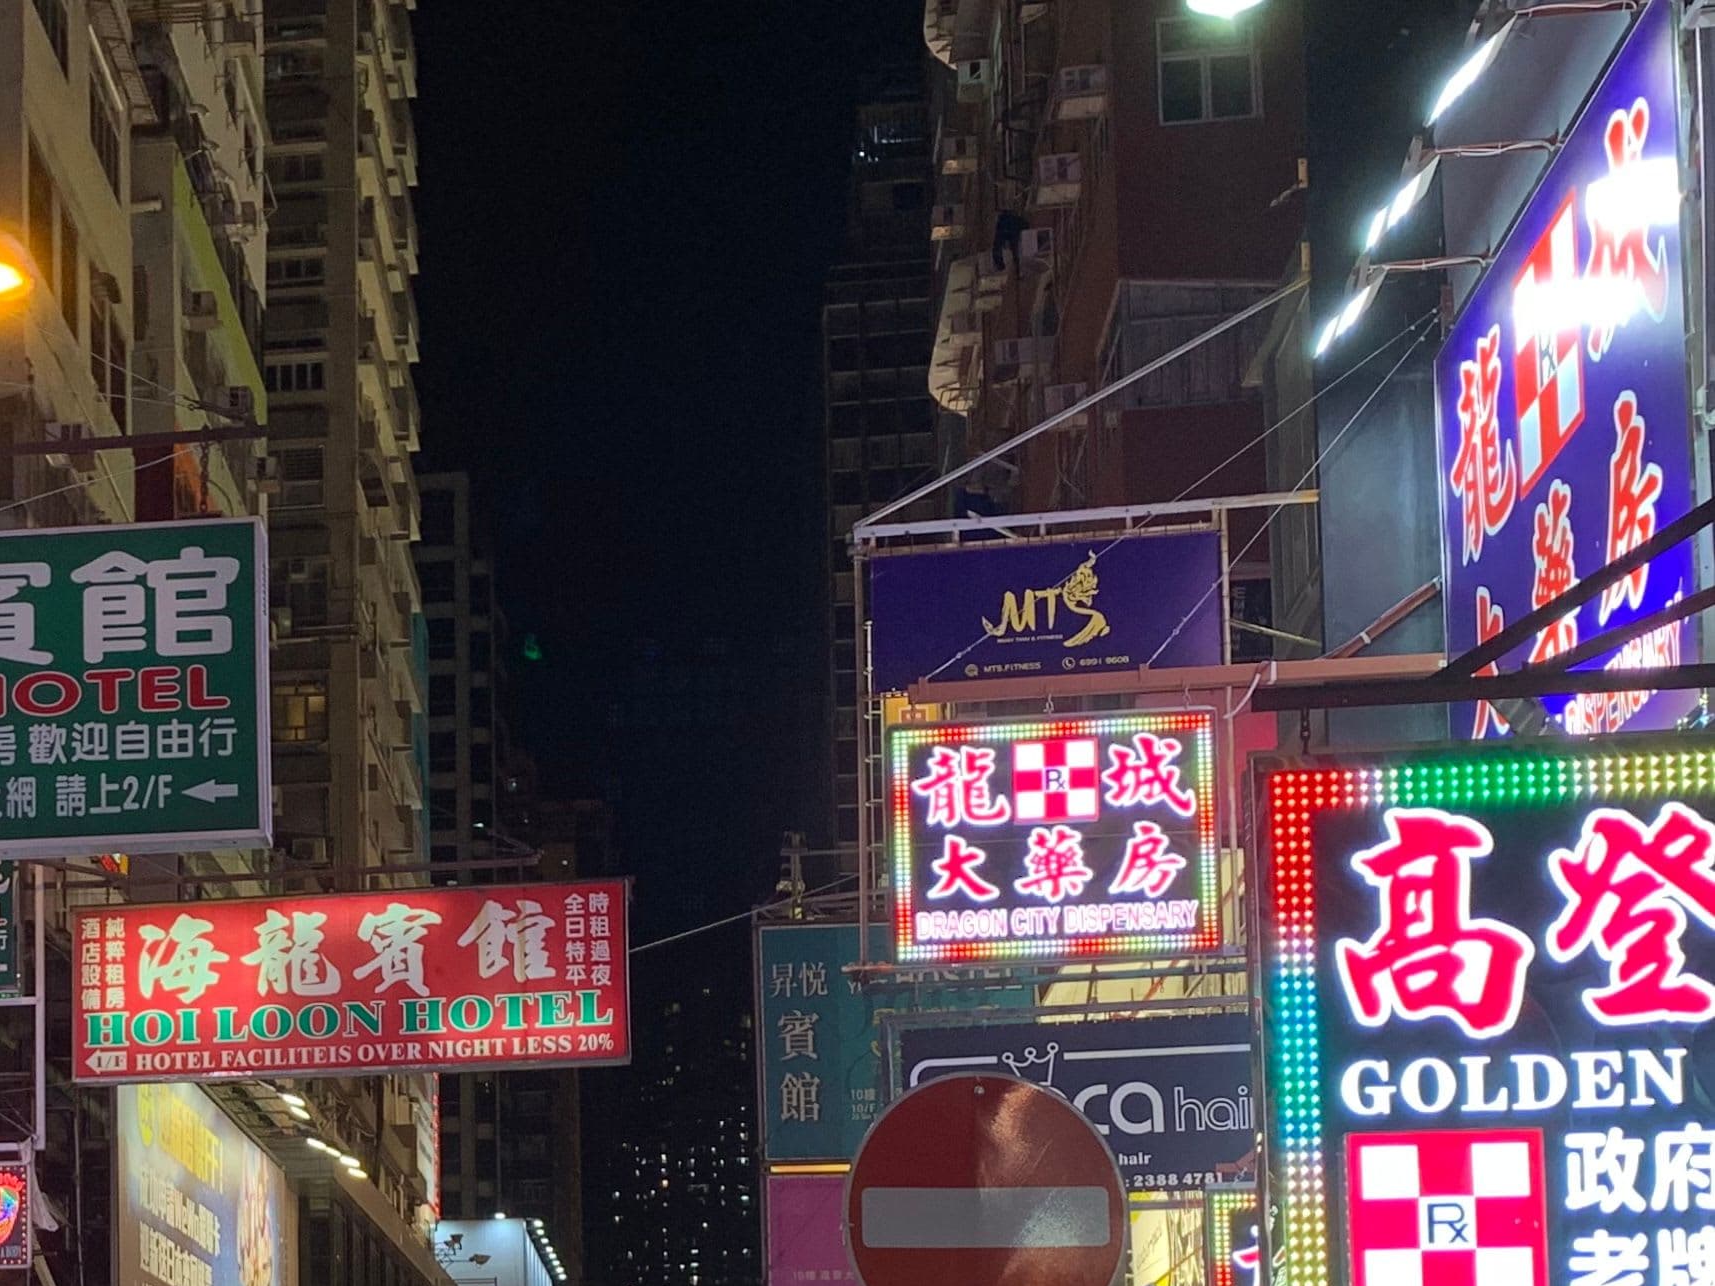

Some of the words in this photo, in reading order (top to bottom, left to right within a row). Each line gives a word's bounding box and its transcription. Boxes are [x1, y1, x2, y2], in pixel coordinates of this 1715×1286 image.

[1452, 324, 1517, 567] 龍
[27, 718, 237, 765] 歡迎自由行
[913, 745, 1012, 828] 龍
[1102, 732, 1197, 818] 城
[928, 821, 1188, 902] 大藥房
[138, 898, 558, 1003] 海龍賓館
[917, 909, 1008, 941] DRAGON
[1011, 907, 1061, 937] CITY
[1064, 900, 1198, 935] DISPENSARY
[1335, 802, 1715, 1038] 高登
[84, 1008, 202, 1048] HOI
[213, 1001, 385, 1044] LOON
[400, 989, 615, 1036] HOTEL
[94, 1055, 126, 1070] 1/F
[135, 1050, 217, 1072] HOTEL
[220, 1044, 353, 1068] FACILITEIS
[356, 1041, 422, 1063] OVER
[428, 1037, 506, 1060] NIGHT
[512, 1035, 572, 1056] LESS
[578, 1032, 615, 1054] 20%
[777, 1009, 821, 1123] 賓館
[1341, 1047, 1687, 1116] GOLDEN
[1174, 1085, 1255, 1134] hai
[1133, 1172, 1179, 1188] 2388
